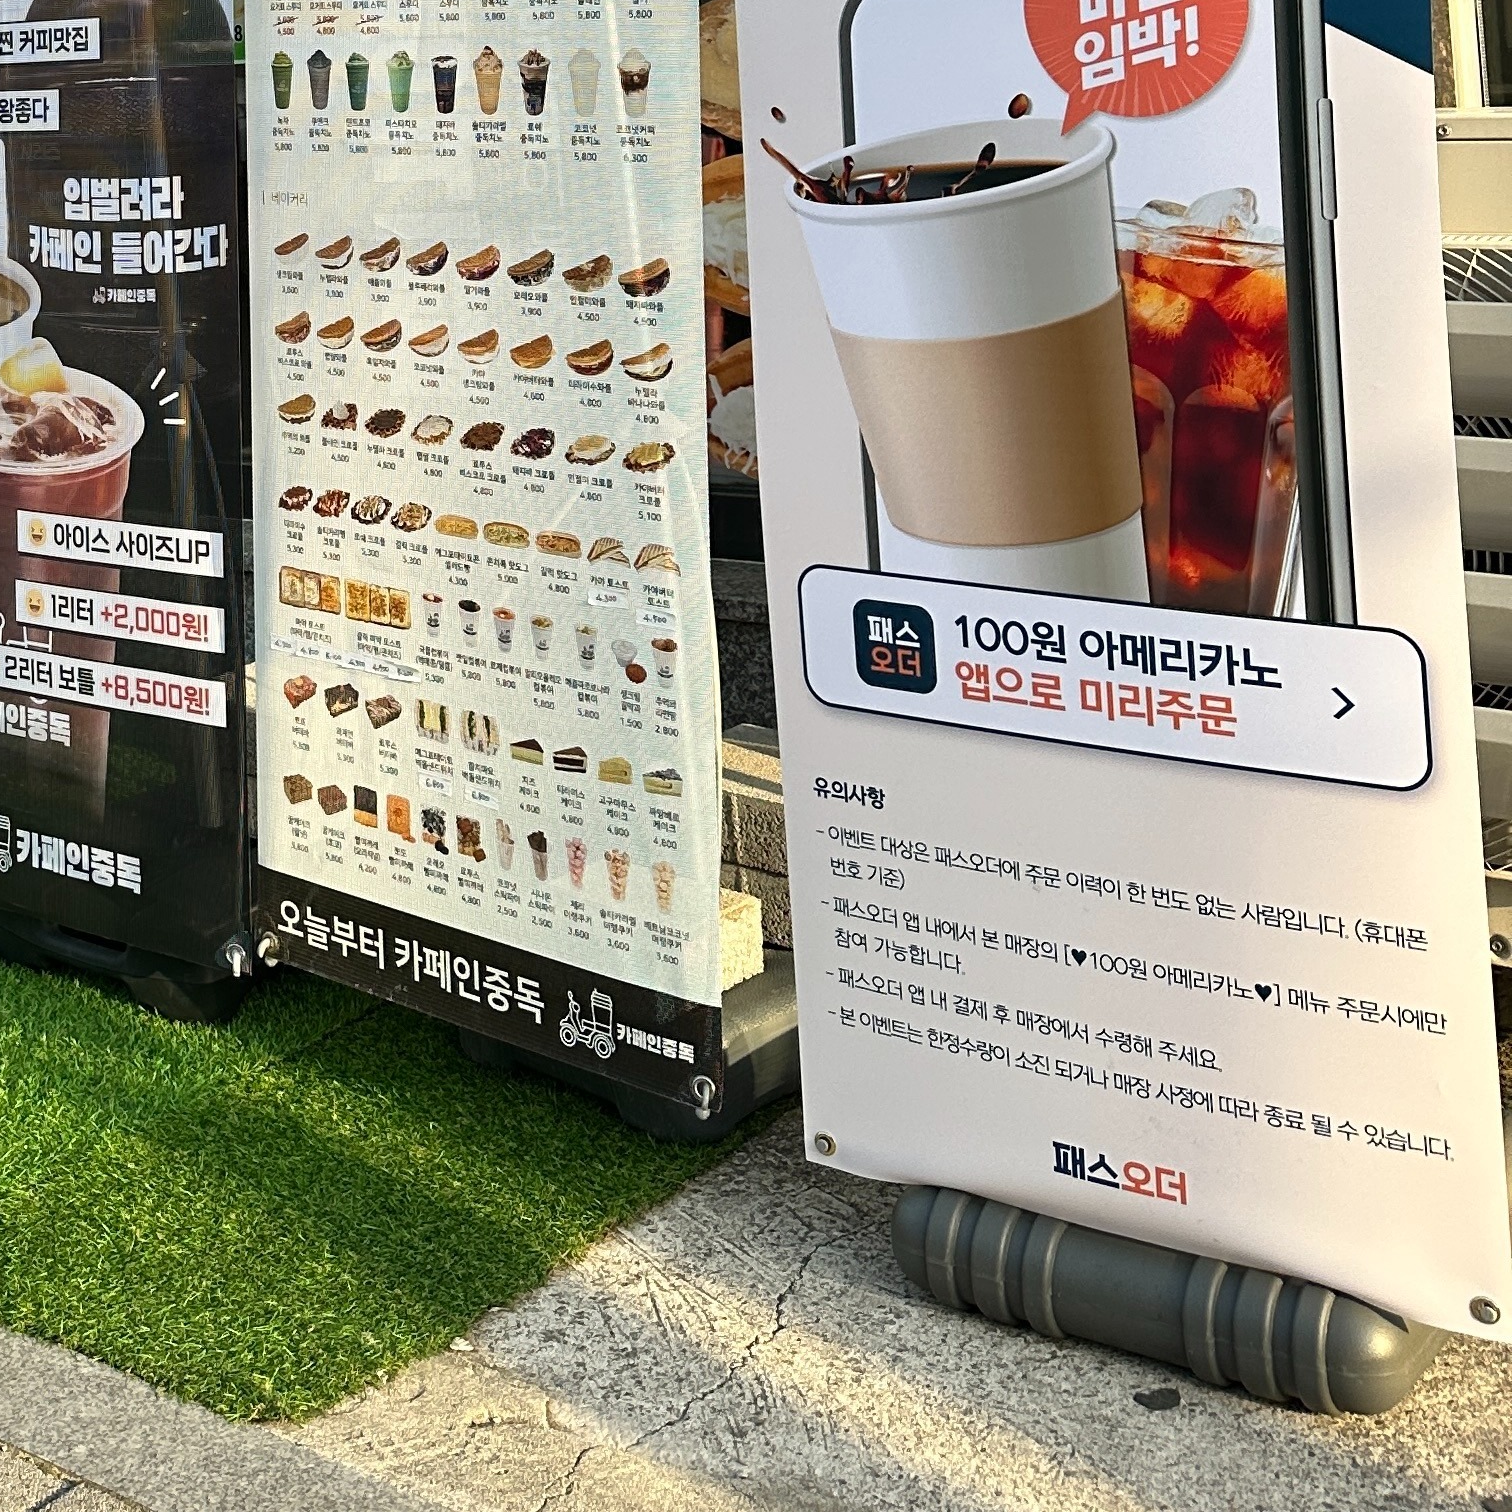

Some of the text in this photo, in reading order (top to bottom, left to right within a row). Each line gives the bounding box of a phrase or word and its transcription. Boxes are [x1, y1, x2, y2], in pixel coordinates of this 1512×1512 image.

[18, 26, 89, 54] 커피맛집
[1074, 5, 1199, 90] 임박!
[63, 176, 184, 222] 입벌려라
[29, 225, 227, 275] 카페인 들어간다
[54, 522, 210, 565] 아이스 사이즈UP
[51, 593, 210, 643] 1리터 +2,000원!
[868, 616, 919, 647] 패스
[870, 647, 921, 678] 오더
[955, 615, 1283, 689] 100원 아메리카노
[4, 656, 210, 716] 2리터 보틀 +8,500원!
[955, 661, 1237, 736] 앱으로 미리주문
[813, 778, 885, 809] 유의사항
[16, 829, 141, 894] 카페인중독
[829, 826, 1428, 951] 이벤트 대상은 패스오더에 주문 이력이 한 번도 없는 사람입니다. (휴대폰
[830, 857, 905, 889] 번호 기준)
[277, 900, 544, 1024] 오늘부터 카페인중독
[833, 896, 897, 926] 패스오더
[903, 909, 920, 931] 앱
[925, 915, 976, 945] 내에서
[981, 927, 999, 947] 본
[1005, 932, 1058, 962] 매장의
[1287, 985, 1329, 1013] 메뉴
[1336, 995, 1447, 1036] 주문시에만
[835, 928, 966, 976] 참여 가능합니다.
[617, 1022, 694, 1064] 카페인중독
[838, 969, 1223, 1074] 패스오더 앱 내 결제 후 매장에서 수령해 주세요.
[840, 1008, 1455, 1163] 본 이벤트는 한정수량이 소진 되거나 매장 사정에 따라 종료 될 수 있습니다.
[1053, 1140, 1187, 1206] 패스오더
